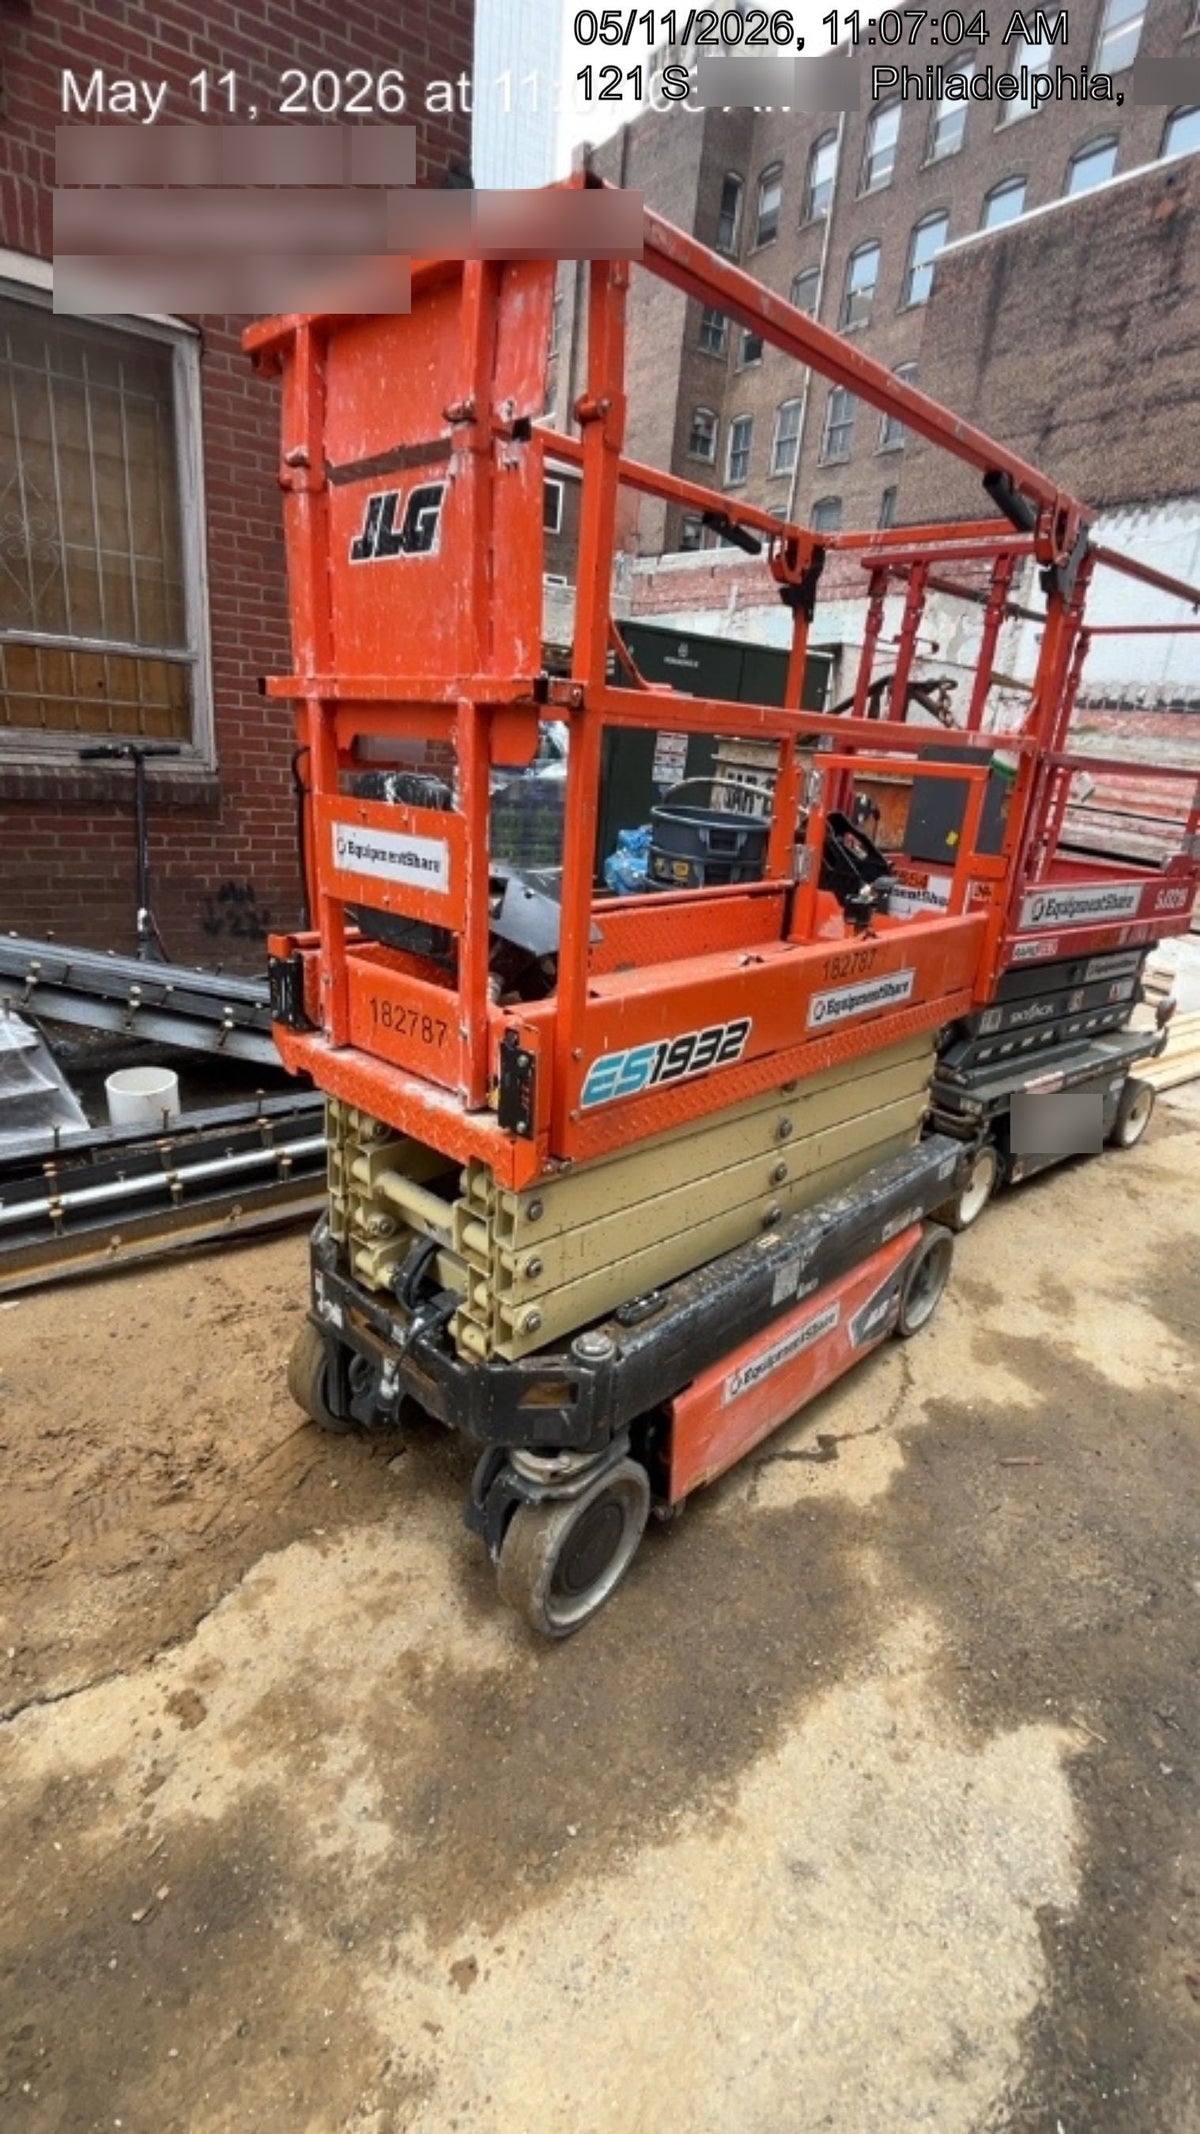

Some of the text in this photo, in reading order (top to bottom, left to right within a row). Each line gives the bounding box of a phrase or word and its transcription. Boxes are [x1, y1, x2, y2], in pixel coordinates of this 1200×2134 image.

[349, 482, 447, 564] JLG
[347, 840, 441, 874] EquipmentShare
[824, 948, 878, 981] 182787
[826, 981, 909, 1016] EquipmentShare
[369, 997, 447, 1049] 182787
[581, 1018, 752, 1109] ES1932
